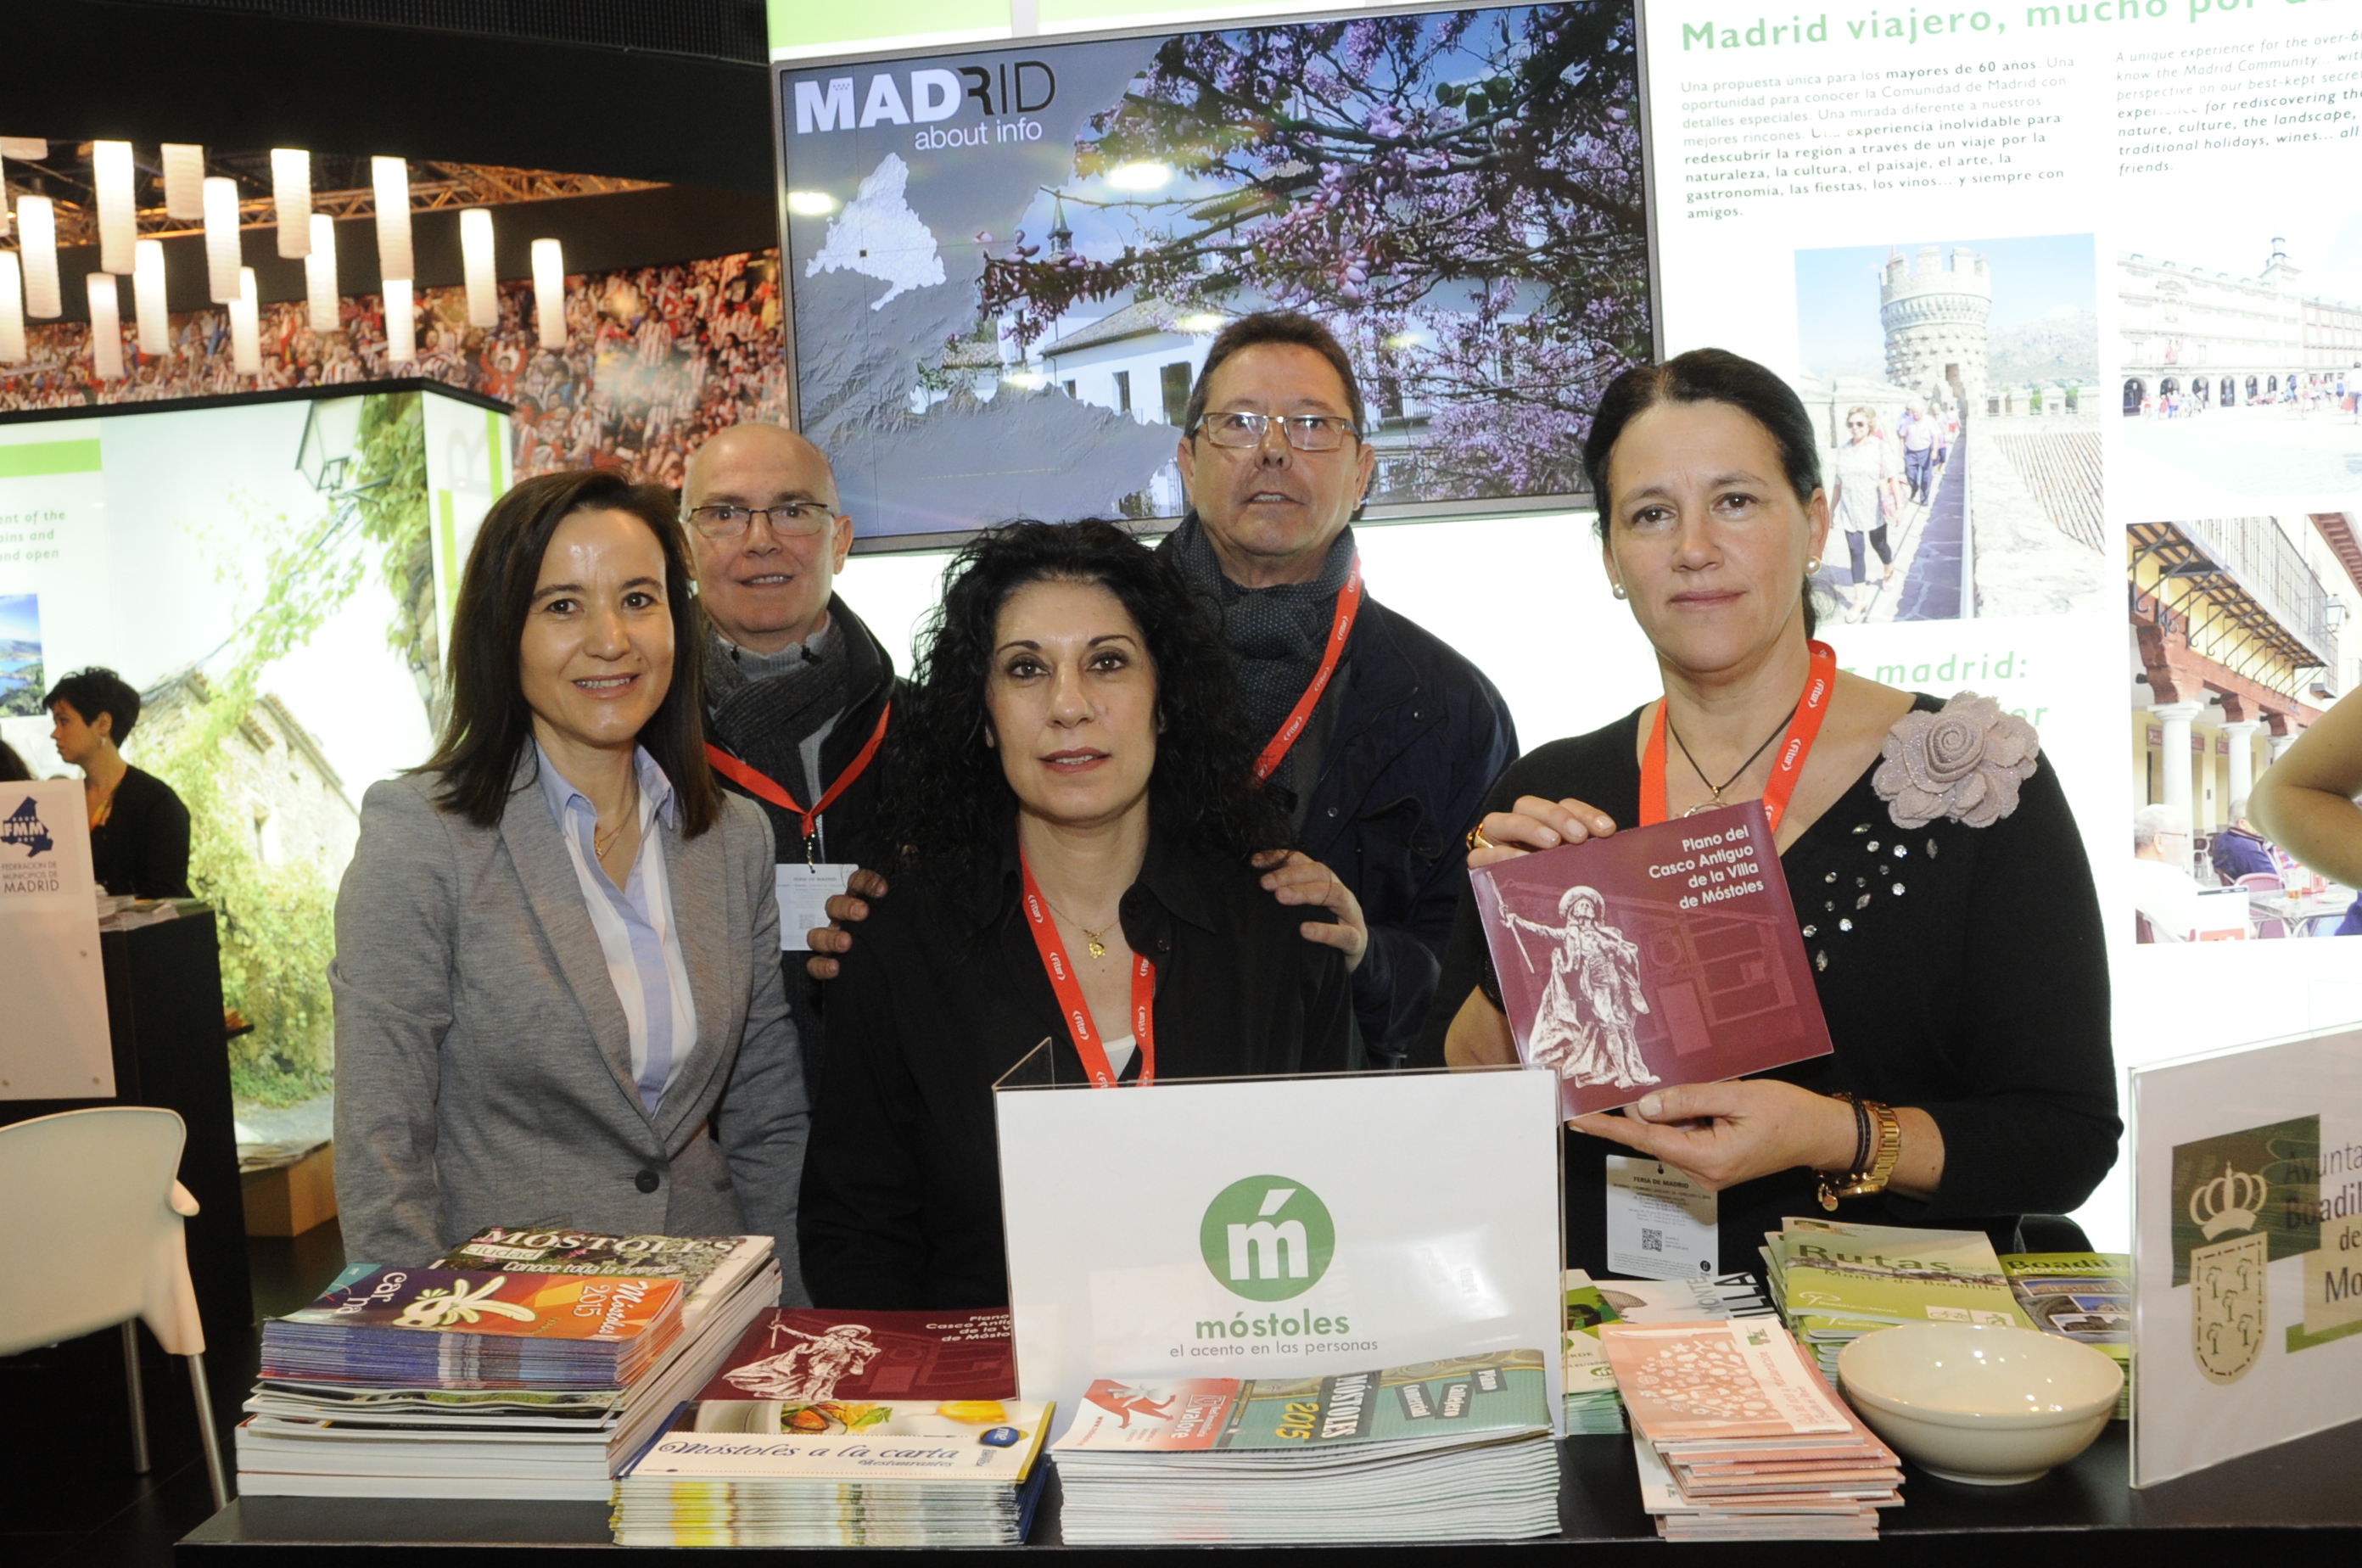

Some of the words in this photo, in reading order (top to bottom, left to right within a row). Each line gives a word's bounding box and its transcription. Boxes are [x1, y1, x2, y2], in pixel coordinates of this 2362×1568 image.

[1682, 13, 1828, 51] Madrid
[1846, 6, 2006, 45] viajero,
[2027, 0, 2169, 28] mucho
[2130, 50, 2175, 64] unique
[2180, 43, 2255, 60] experience
[2260, 38, 2280, 53] for
[2285, 36, 2309, 49] the
[1680, 81, 1709, 93] Una
[1712, 78, 1782, 94] propuesta
[1786, 74, 1822, 87] única
[1826, 73, 1857, 87] para
[1861, 70, 1881, 81] los
[1885, 67, 1950, 81] mayores
[1978, 60, 1996, 74] 60
[2046, 56, 2075, 69] Una
[2116, 70, 2151, 81] know
[2157, 66, 2178, 79] the
[2183, 61, 2233, 76] Madrid
[794, 60, 1056, 134] MADRID
[1681, 94, 1766, 114] oportunidad
[1770, 95, 1800, 109] para
[1804, 91, 1861, 104] conocer
[1881, 81, 1961, 98] Comunidad
[1987, 76, 2036, 91] Madrid
[2041, 77, 2066, 87] con
[2116, 86, 2193, 104] perspective
[2220, 82, 2243, 92] our
[2247, 74, 2316, 90] best-kept
[2204, 100, 2227, 115] for
[2232, 91, 2337, 110] rediscovering
[1682, 111, 1737, 127] detalles
[1817, 108, 1845, 120] Una
[1850, 104, 1897, 118] mirada
[1901, 102, 1965, 115] diferente
[1982, 98, 2042, 109] nuestros
[2242, 115, 2268, 128] the
[915, 122, 988, 151] about
[996, 117, 1044, 143] info
[1683, 135, 1738, 148] mejores
[1846, 120, 1934, 139] experiencia
[1939, 115, 2022, 132] inolvidable
[2027, 115, 2062, 129] para
[2118, 138, 2199, 156] traditional
[2339, 125, 2360, 139] all
[1683, 148, 1772, 165] redescubrir
[1794, 144, 1843, 160] región
[1861, 140, 1909, 154] través
[1960, 135, 1996, 150] viaje
[2001, 135, 2028, 148] por
[1788, 182, 1810, 195] las
[1872, 178, 1894, 190] los
[1971, 171, 2033, 185] siempre
[2037, 170, 2064, 180] con
[24, 509, 39, 525] of
[43, 509, 66, 521] the
[29, 527, 55, 541] and
[25, 549, 59, 563] open
[1874, 650, 2028, 685] madrid:
[1682, 833, 1723, 853] Plano
[1725, 824, 1750, 843] del
[1648, 860, 1696, 879] Casco
[1699, 845, 1755, 868] Antiguo
[1688, 874, 1708, 888] de
[1709, 870, 1726, 884] la
[1726, 862, 1759, 879] Villa
[3, 879, 60, 893] MADRID
[1679, 895, 1699, 910] de
[1701, 880, 1765, 904] Móstoles
[465, 1245, 540, 1259] ciudad
[471, 1229, 739, 1254] MÓSTOLES
[502, 1261, 562, 1272] Conoce
[1799, 1244, 1951, 1272] Rutas
[573, 1284, 611, 1318] 2015
[597, 1280, 649, 1335] Móstoles
[969, 1313, 1010, 1322] Plano
[1195, 1308, 1351, 1340] móstoles
[966, 1331, 1011, 1341] Mósto
[1170, 1343, 1184, 1358] el
[1190, 1343, 1245, 1357] acento
[1251, 1344, 1270, 1356] en
[1276, 1341, 1299, 1354] las
[1306, 1339, 1379, 1356] personas
[1477, 1369, 1498, 1392] Plano
[1321, 1373, 1373, 1438] MÓSTOLES
[1402, 1383, 1431, 1418] Comercial
[1442, 1383, 1469, 1417] Callejero
[1170, 1406, 1205, 1439] valore
[1275, 1402, 1319, 1440] 2015
[658, 1440, 801, 1459] Móstoles
[808, 1446, 831, 1459] a
[836, 1443, 872, 1459] la
[879, 1448, 960, 1460] carta
